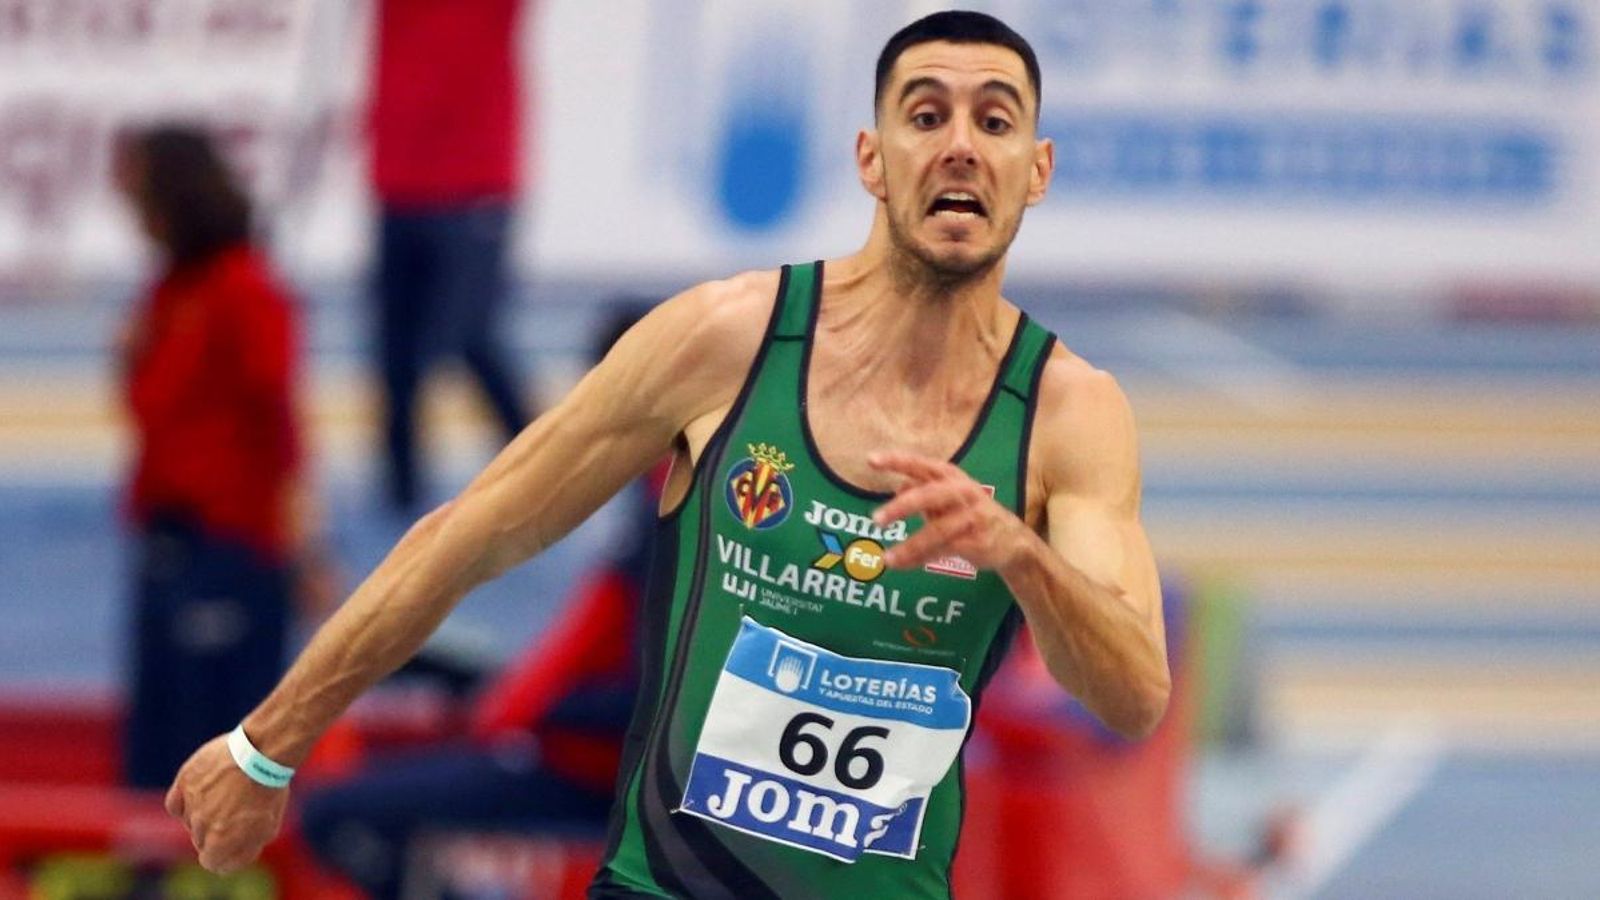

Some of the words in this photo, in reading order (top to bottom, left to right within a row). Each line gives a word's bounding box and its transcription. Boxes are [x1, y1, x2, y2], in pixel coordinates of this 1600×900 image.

[849, 547, 881, 569] Fer
[716, 534, 907, 617] VILLARREAL
[915, 596, 966, 624] C.F
[722, 573, 757, 601] UJI
[820, 669, 937, 704] LOTERÍAS
[894, 702, 933, 714] ESTADO
[779, 712, 890, 789] 66
